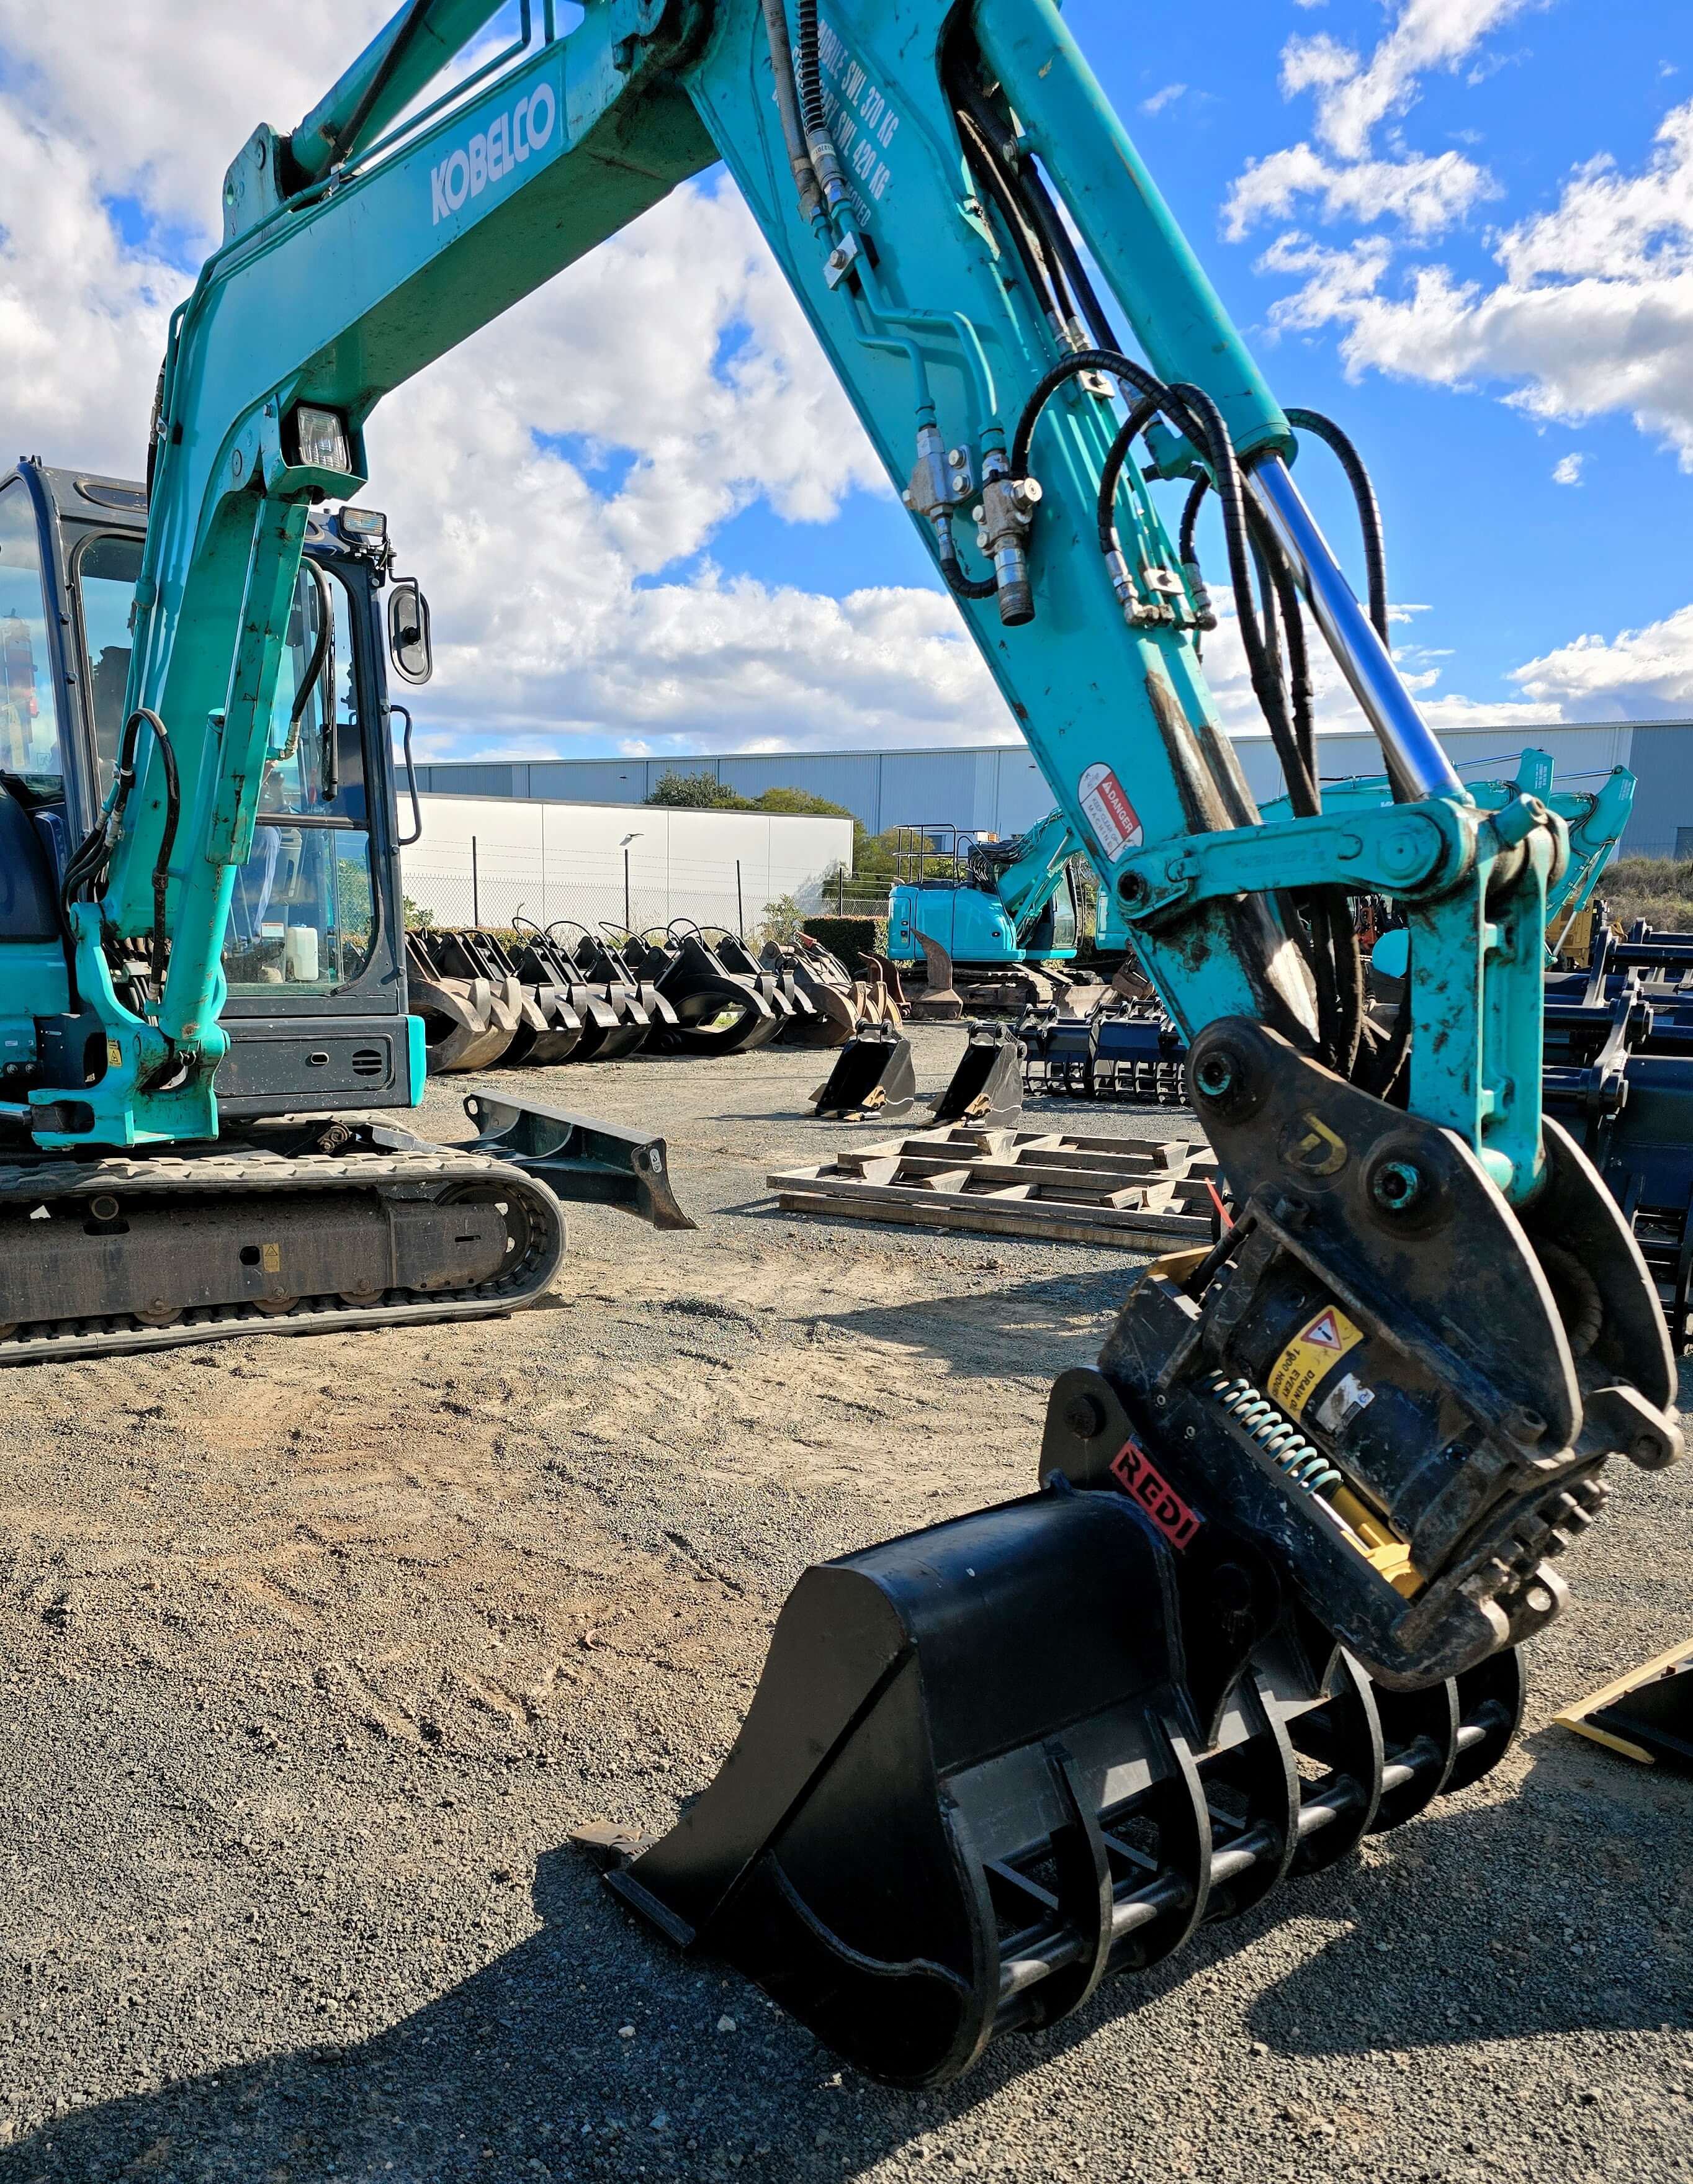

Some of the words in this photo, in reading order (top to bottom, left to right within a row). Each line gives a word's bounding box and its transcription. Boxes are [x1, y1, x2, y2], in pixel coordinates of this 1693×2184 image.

[841, 60, 867, 107] SWL
[860, 86, 884, 129] 370
[877, 109, 899, 148] KG
[431, 83, 555, 226] KOBELCO
[832, 110, 858, 157] SWL
[853, 139, 876, 180] 420
[869, 162, 891, 200] KG
[1102, 814, 1113, 834] CLEAR
[1107, 791, 1133, 834] DANGER
[1282, 1348, 1300, 1372] 1000
[1282, 1369, 1301, 1399] EVERY
[1293, 1370, 1315, 1401] DRAIN
[1117, 1449, 1193, 1539] REDI
